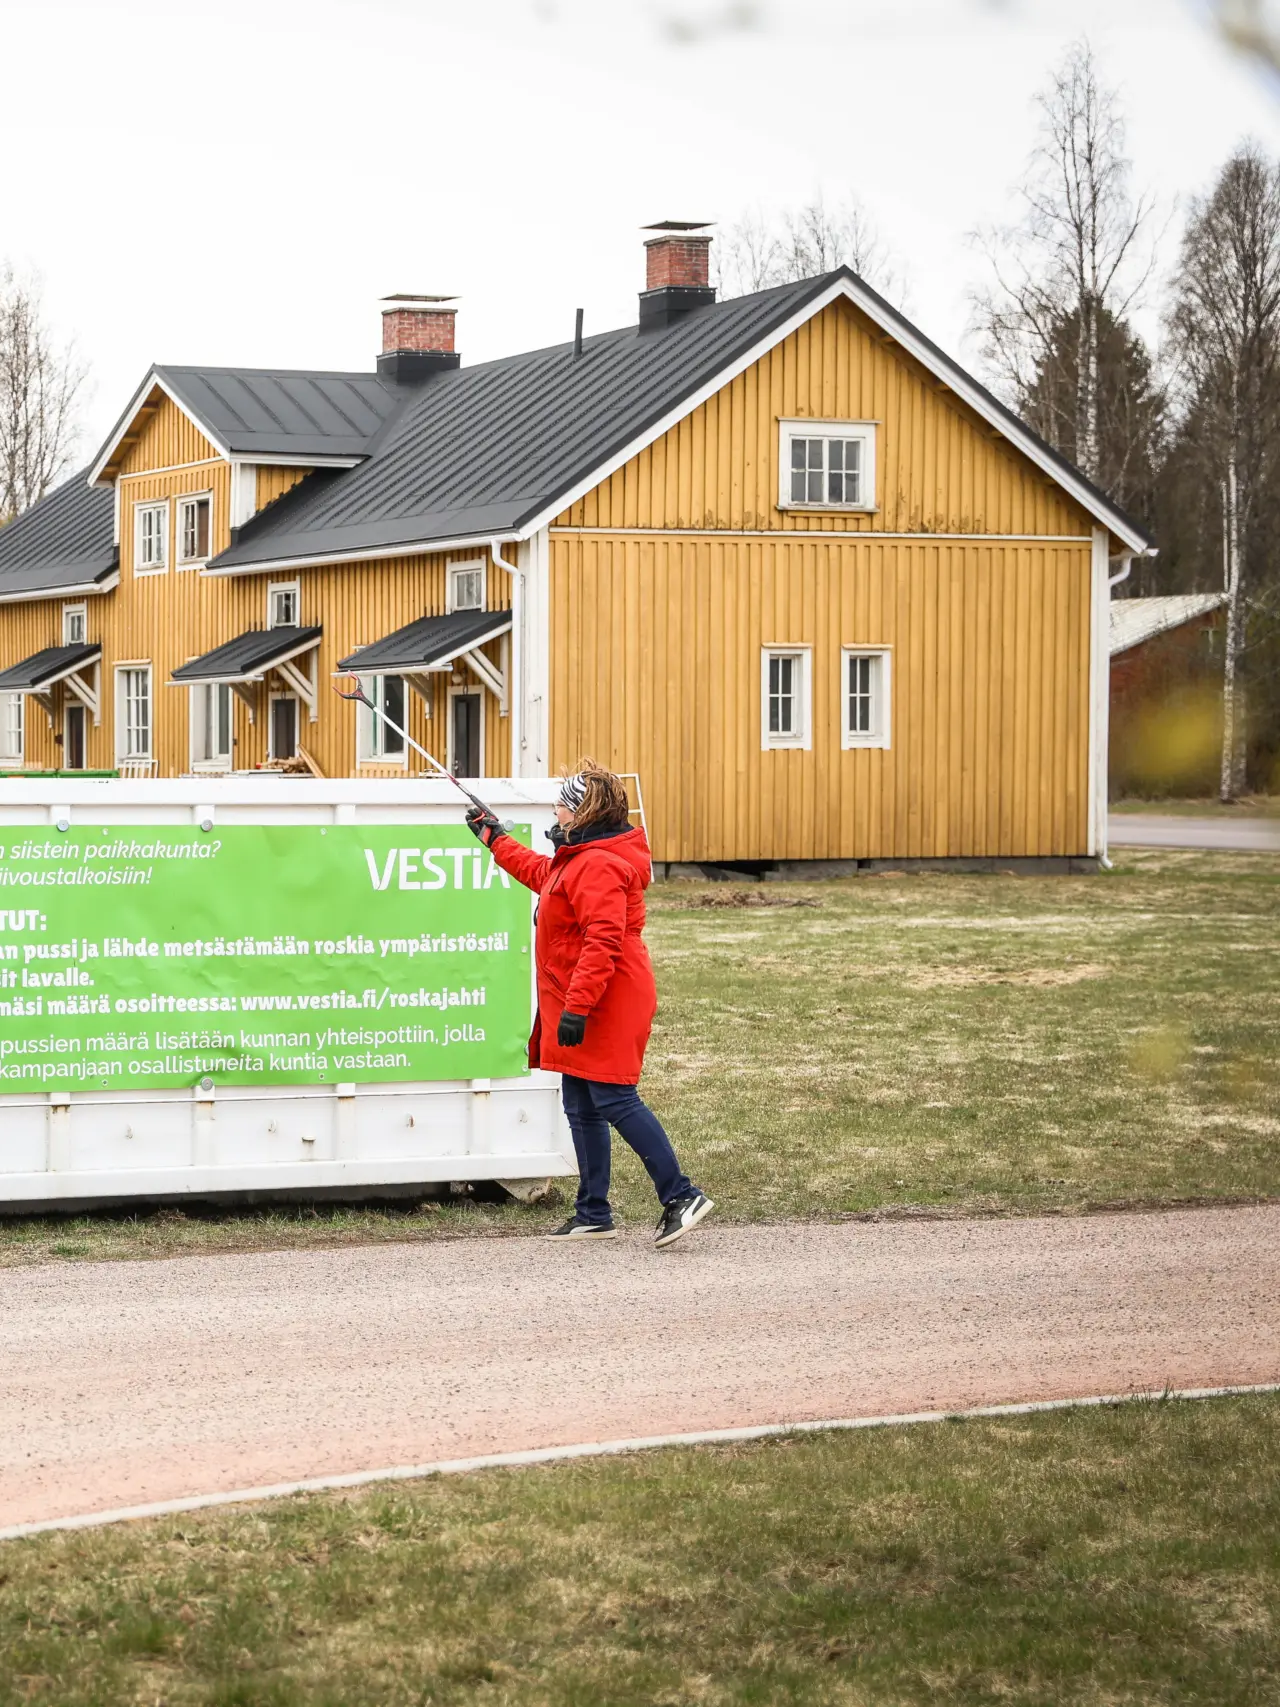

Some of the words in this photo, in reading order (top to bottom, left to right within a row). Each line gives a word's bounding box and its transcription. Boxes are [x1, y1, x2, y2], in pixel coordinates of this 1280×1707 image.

[10, 840, 79, 859] siistein
[84, 840, 221, 862] paikkakunta?
[23, 939, 77, 964] pussi
[79, 939, 99, 962] ja
[104, 938, 160, 957] lähde
[164, 936, 309, 956] metsästämään
[314, 935, 375, 954] roskia
[379, 932, 508, 957] ympäristöstä!
[22, 967, 94, 987] lavalle.
[47, 994, 110, 1015] määrä
[115, 993, 237, 1013] osoitteessa:
[240, 987, 485, 1010] www.vestia.fi/roskajahti
[87, 1032, 149, 1051] määrä
[156, 1031, 234, 1049] lisätään
[240, 1030, 310, 1047] kunnan
[316, 1025, 438, 1050] yhteispottiin,
[442, 1024, 485, 1046] jolla
[128, 1055, 263, 1074] osallistuneita
[270, 1052, 328, 1070] kuntia
[334, 1052, 410, 1068] vastaan.
